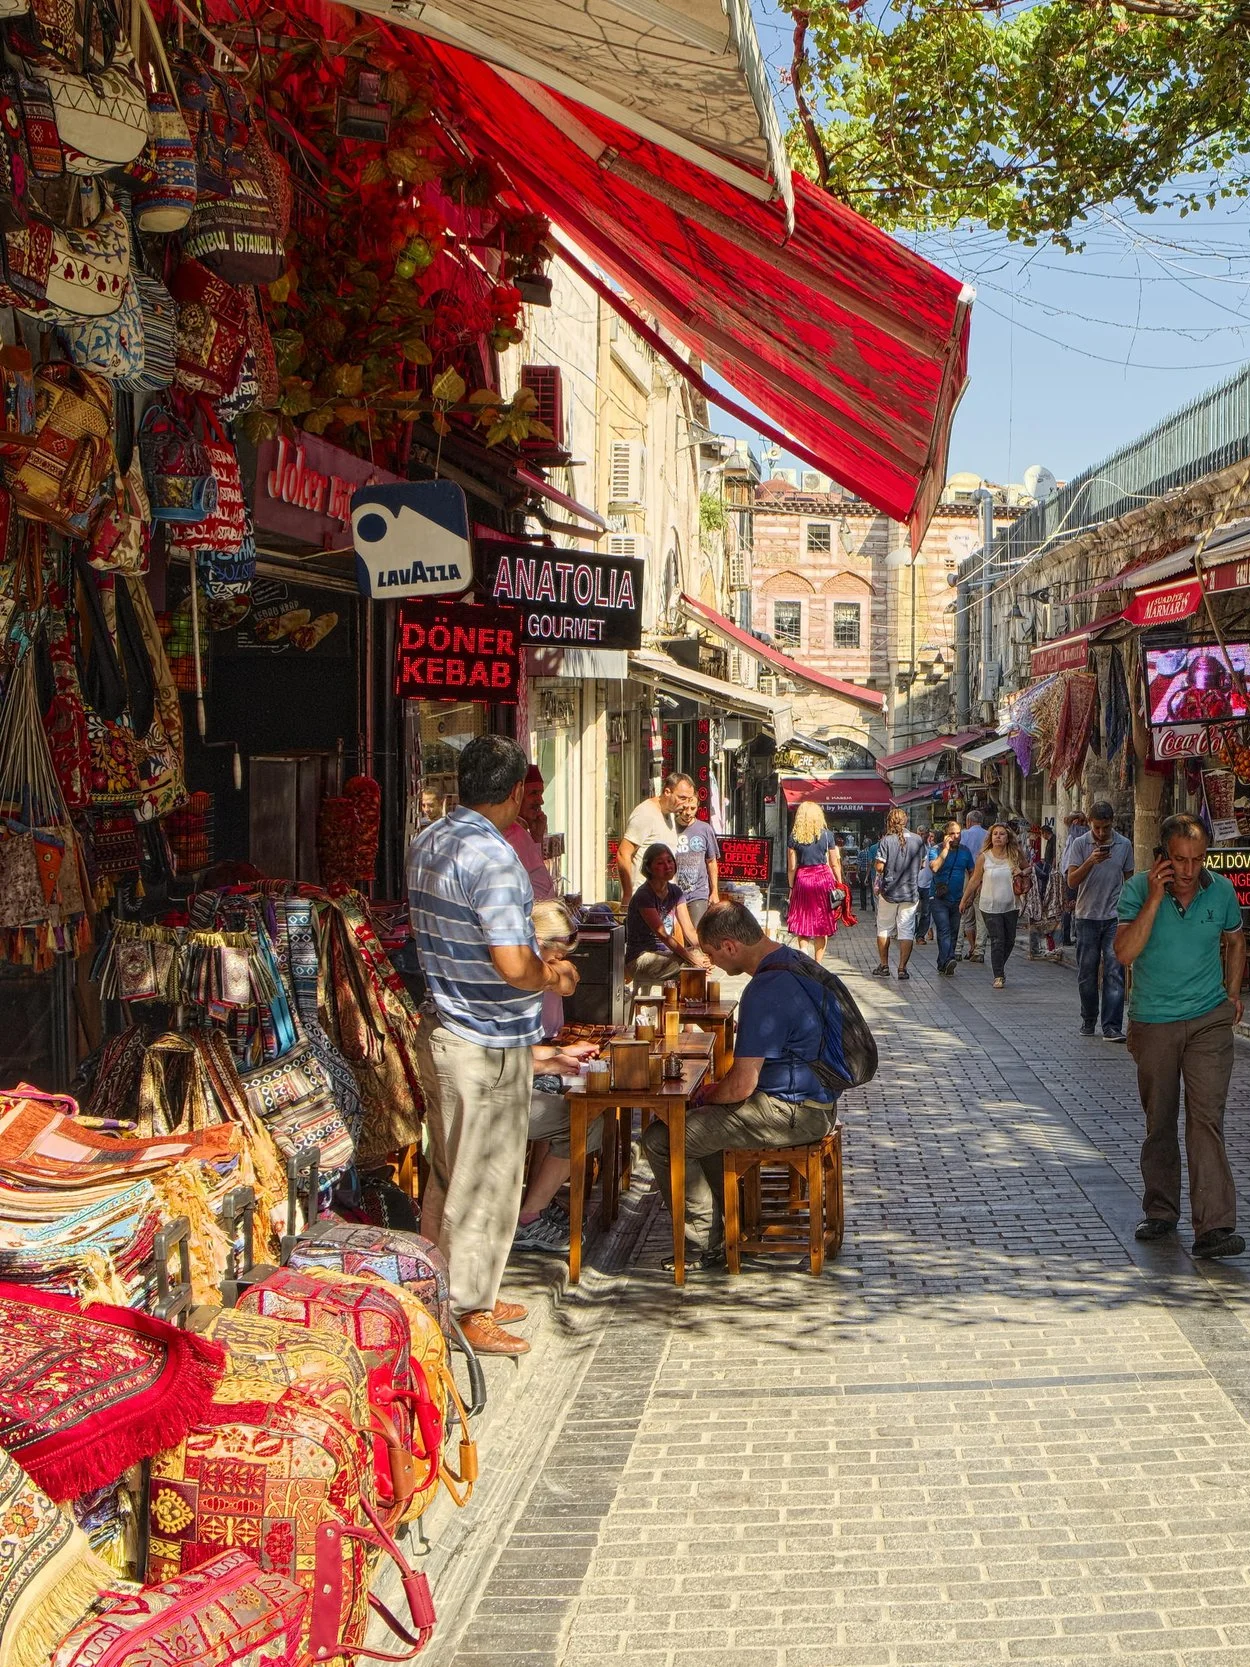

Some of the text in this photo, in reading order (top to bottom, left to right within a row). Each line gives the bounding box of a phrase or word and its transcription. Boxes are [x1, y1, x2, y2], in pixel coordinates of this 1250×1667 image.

[233, 232, 273, 255] ISTANBUL
[378, 560, 462, 588] LAVAZZA
[493, 556, 635, 609] ANATOLIA
[402, 617, 515, 655] DÖNER
[528, 614, 605, 640] GOURMET
[403, 657, 511, 687] KEBAB
[827, 804, 836, 813] by
[722, 842, 761, 854] CHANGE
[725, 852, 758, 864] OFFICE
[744, 867, 758, 876] NO
